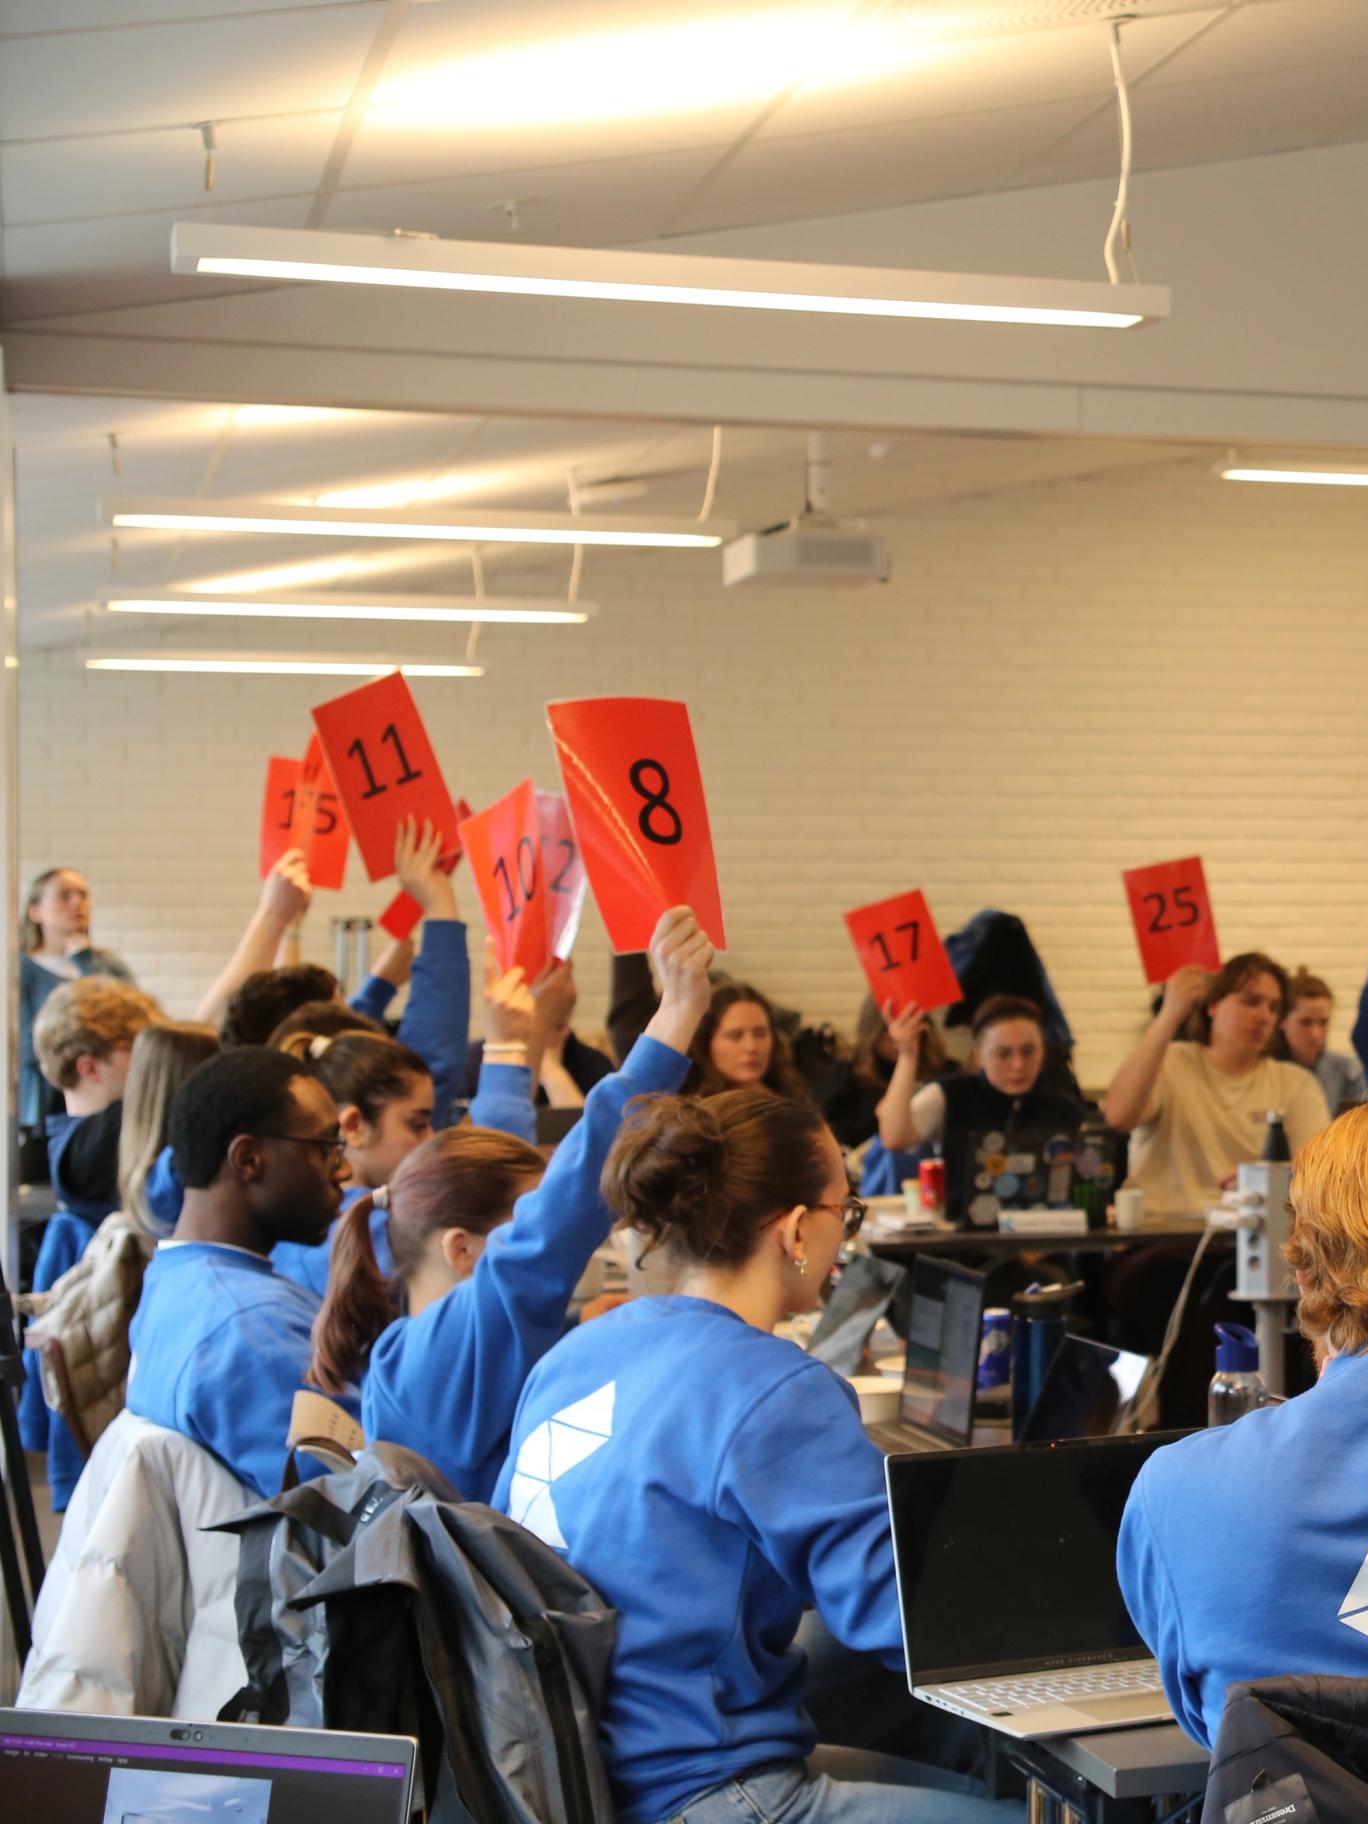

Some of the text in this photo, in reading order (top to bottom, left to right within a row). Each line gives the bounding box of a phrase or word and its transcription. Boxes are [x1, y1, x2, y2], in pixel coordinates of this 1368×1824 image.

[346, 723, 422, 799] 11
[629, 758, 682, 845] 8
[493, 836, 537, 922] 10
[541, 833, 576, 893] 2
[1143, 885, 1199, 933] 25
[869, 920, 919, 972] 17
